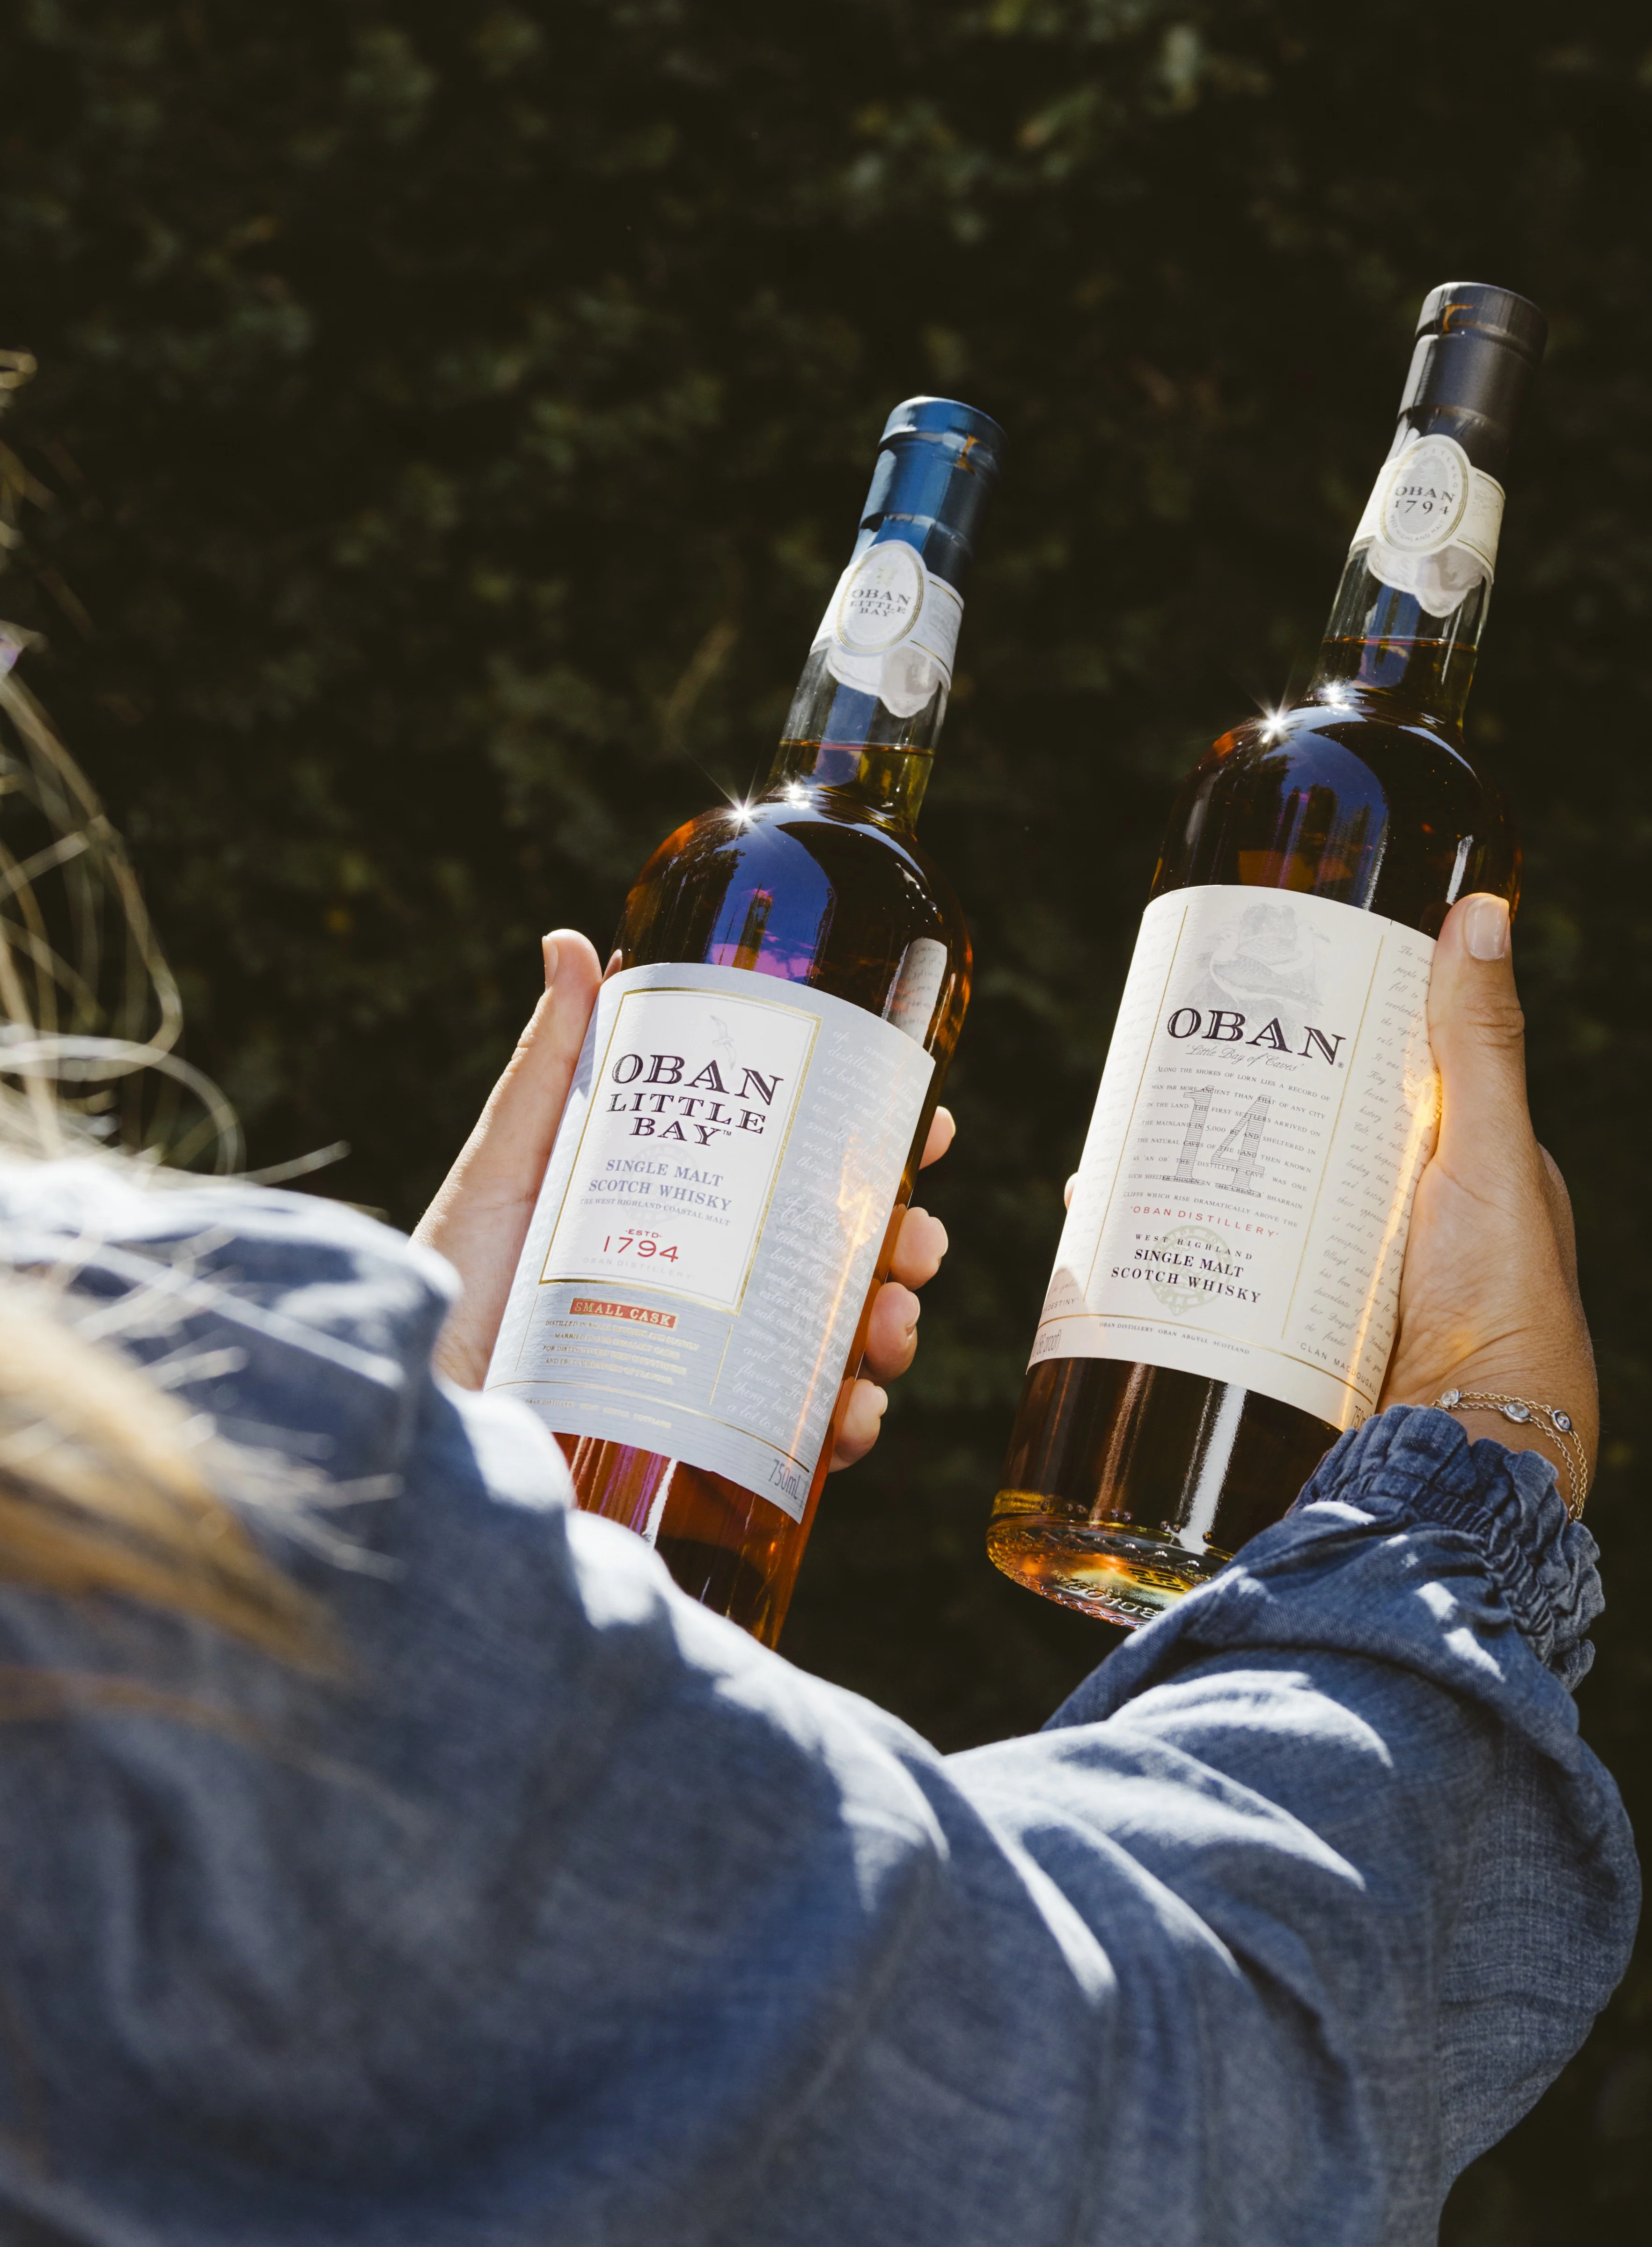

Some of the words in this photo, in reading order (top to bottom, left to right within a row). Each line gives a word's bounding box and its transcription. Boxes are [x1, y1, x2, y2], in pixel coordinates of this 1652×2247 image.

[1395, 486, 1455, 503] OBAN
[1395, 500, 1449, 515] 1794
[1396, 529, 1431, 541] HIGHLAND
[1431, 520, 1445, 533] MALT
[850, 600, 906, 614] LITTLE
[851, 588, 912, 605] OBAN
[1397, 945, 1413, 957] The
[1393, 966, 1417, 979] people
[1388, 981, 1409, 993] fell
[1385, 1001, 1423, 1023] overlordship
[1397, 1026, 1419, 1039] eighth
[827, 1045, 881, 1083] distillery
[863, 1045, 906, 1072] around
[1219, 1048, 1245, 1065] Bay
[1247, 1053, 1267, 1067] of
[612, 1053, 784, 1106] OBAN
[836, 1068, 877, 1100] between
[1366, 1070, 1387, 1086] King
[1288, 1085, 1318, 1097] RECORD
[1363, 1087, 1389, 1104] became
[606, 1093, 766, 1134] LITTLE
[1201, 1087, 1230, 1096] ANCIENT
[1257, 1096, 1276, 1105] THAT
[1309, 1110, 1326, 1119] CITY
[1234, 1111, 1271, 1123] SETTLERS
[1274, 1120, 1307, 1133] ARRIVED
[1358, 1105, 1382, 1124] history
[806, 1121, 848, 1144] small
[1162, 1085, 1271, 1198] 14
[1262, 1136, 1304, 1152] SHELTERED
[605, 1159, 668, 1175] SINGLE
[673, 1166, 724, 1188] MALT
[796, 1155, 833, 1182] things
[1260, 1154, 1281, 1164] THEN
[1284, 1160, 1312, 1173] KNOWN
[1346, 1159, 1370, 1178] leading
[1174, 1176, 1200, 1185] HIDDEN
[1267, 1194, 1303, 1210] BHARRAIN
[1272, 1176, 1286, 1185] WAS
[1292, 1182, 1307, 1192] ONE
[588, 1179, 652, 1194] SCOTCH
[659, 1184, 732, 1212] WHISKY
[1363, 1186, 1386, 1206] lasting
[617, 1198, 661, 1210] HIGHLAND
[663, 1205, 704, 1219] COASTAL
[705, 1214, 731, 1226] MALT
[780, 1208, 814, 1234] Oban
[800, 1200, 840, 1232] fruity
[1193, 1198, 1251, 1214] DRAMATICALLY
[1254, 1211, 1279, 1222] ABOVE
[1283, 1219, 1298, 1228] THE
[603, 1235, 679, 1263] 1794
[775, 1230, 805, 1252] takes
[1135, 1234, 1168, 1243] WEST
[1177, 1239, 1252, 1260] HIGHLAND
[1326, 1234, 1367, 1256] precipitous
[770, 1247, 805, 1272] batch
[1134, 1248, 1195, 1267] SINGLE
[1198, 1258, 1244, 1278] MALT
[764, 1270, 798, 1287] malt
[1354, 1266, 1373, 1279] which
[1110, 1267, 1179, 1285] SCOTCH
[1188, 1276, 1262, 1303] WHISKY
[759, 1289, 791, 1309] extra
[792, 1302, 816, 1322] time
[1313, 1286, 1351, 1309] descendants
[575, 1301, 624, 1317] SMALL
[630, 1308, 670, 1327] CASK
[1328, 1312, 1357, 1331] Dougall
[749, 1328, 777, 1344] more
[1116, 1323, 1154, 1333] DISTILLERY
[1158, 1329, 1177, 1337] OBAN
[1180, 1333, 1209, 1344] ARGYLL
[1212, 1340, 1250, 1355] SCOTLAND
[1322, 1331, 1347, 1347] founder
[739, 1403, 760, 1422] lot
[771, 1397, 788, 1416] but
